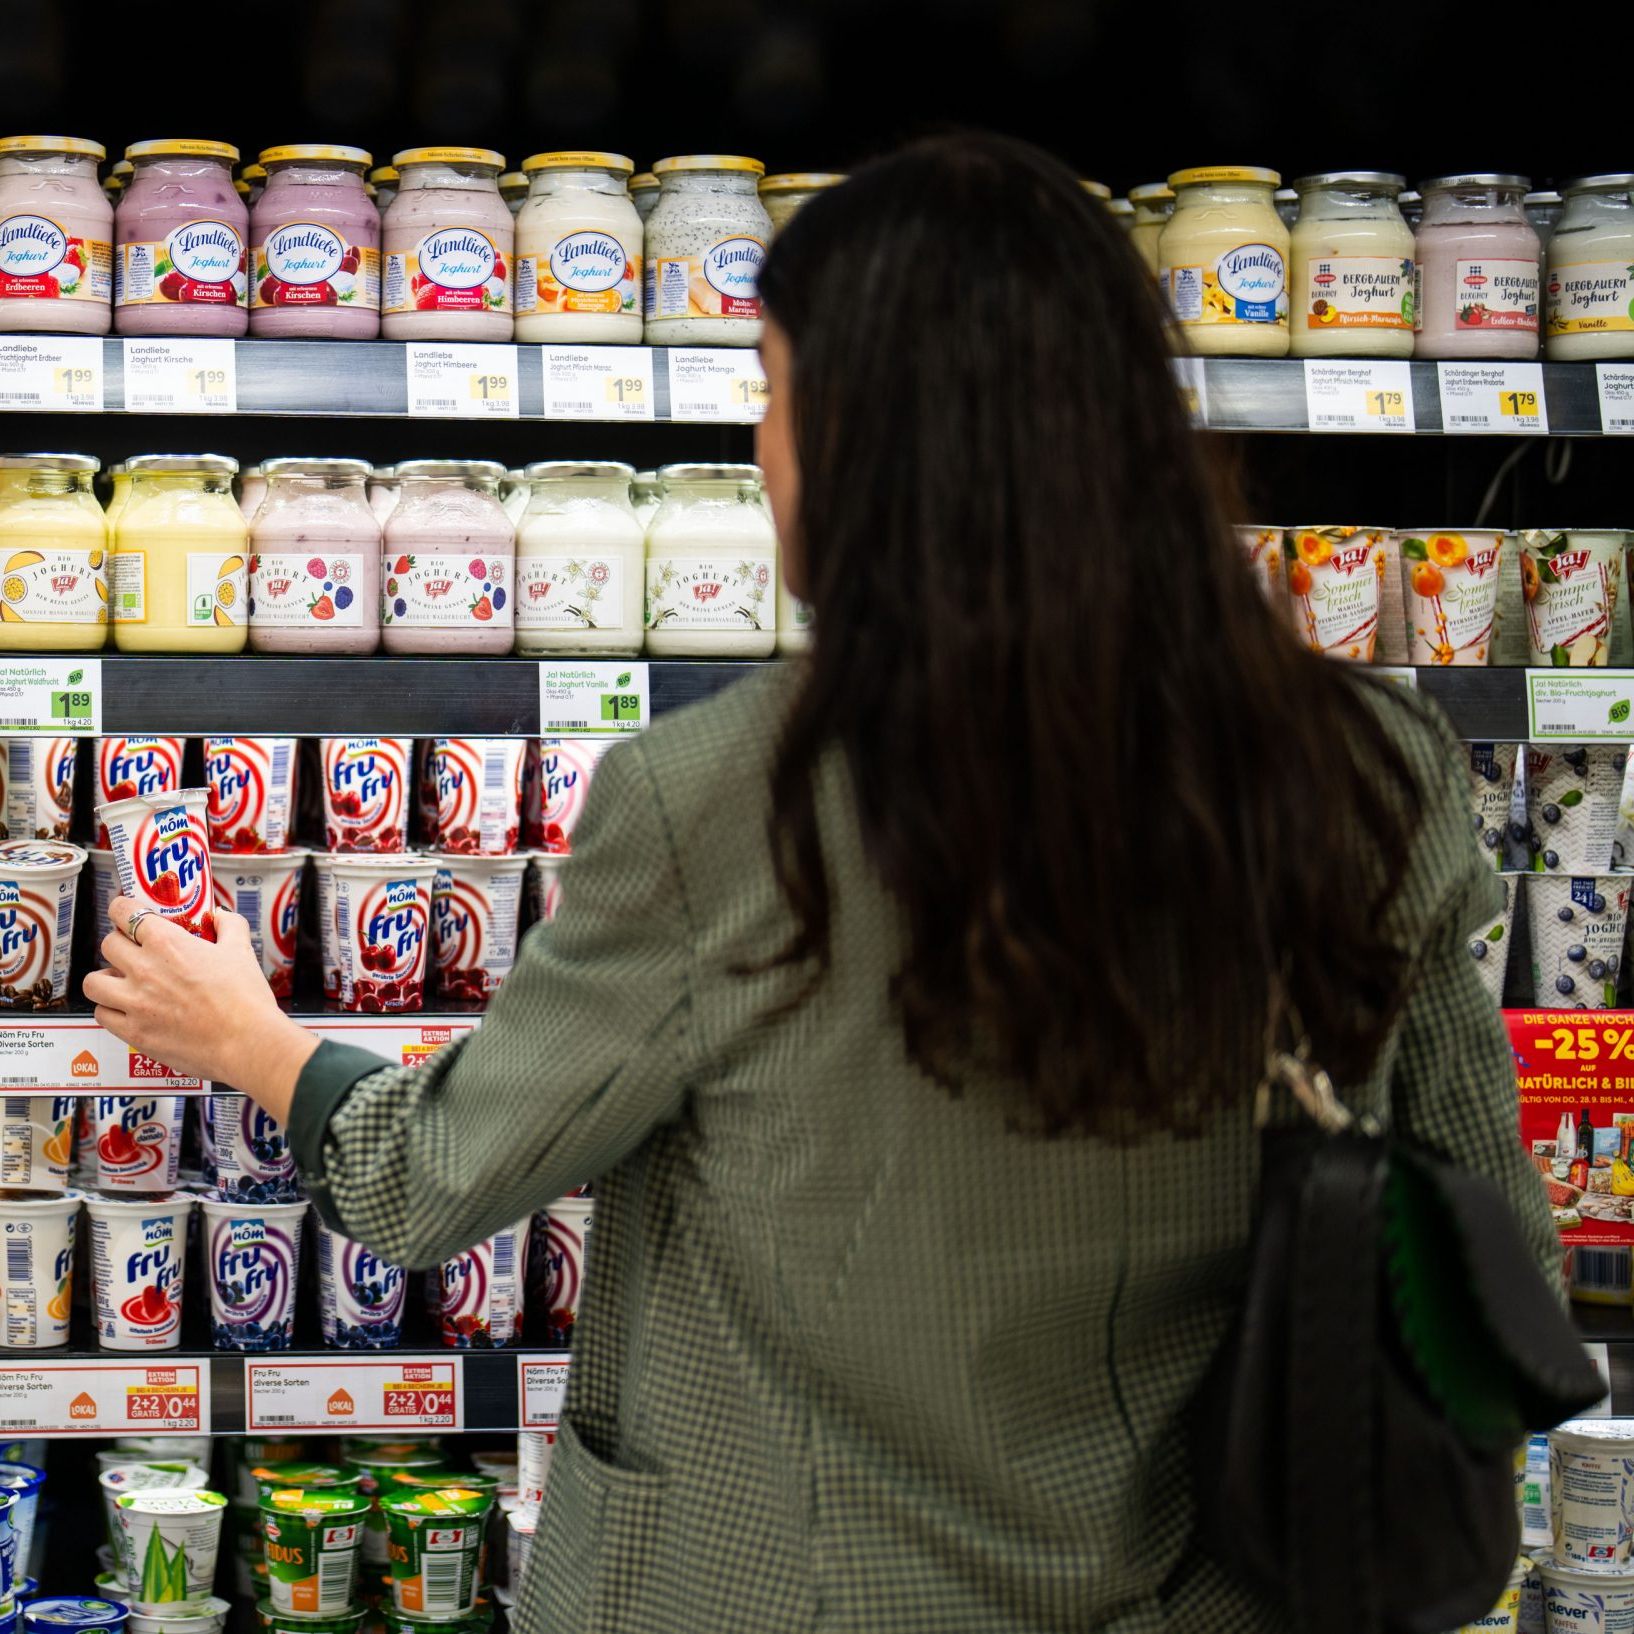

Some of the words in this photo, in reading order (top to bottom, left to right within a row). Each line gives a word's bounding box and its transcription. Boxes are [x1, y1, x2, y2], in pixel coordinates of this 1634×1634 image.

[0, 223, 61, 250] Landliebe
[179, 229, 238, 258] Landliebe
[274, 231, 338, 258] Landliebe
[427, 236, 491, 263] Landliebe
[5, 251, 49, 264] Joghurt
[558, 240, 623, 266] Landliebe
[188, 255, 230, 270] Joghurt
[283, 257, 327, 272] Joghurt
[438, 262, 482, 276] Joghurt
[1227, 252, 1283, 277] Landliebe
[569, 264, 613, 279] Joghurt
[1343, 273, 1400, 285] BERGBAUERN
[5, 283, 46, 292] Erdbeeren
[1238, 277, 1275, 291] Joghurt
[1565, 278, 1627, 293] BERGBAUERN
[193, 289, 226, 298] Kirschen
[285, 291, 321, 300] Kirschen
[437, 295, 481, 304] Himbeeren
[1350, 286, 1395, 302] Joghurt
[1501, 288, 1536, 305] Joghurt
[1570, 290, 1619, 308] Joghurt
[1244, 308, 1269, 318] Vanille
[1578, 320, 1608, 329] Vanille
[130, 346, 170, 354] Landliebe
[413, 351, 453, 359] Landliebe
[130, 356, 162, 365] Joghurt
[549, 354, 589, 362] Landliebe
[675, 355, 714, 364] Landliebe
[1480, 370, 1505, 379] Berghof
[32, 563, 93, 581] JOGHURT
[408, 568, 471, 586] JOGHURT
[676, 572, 739, 589] JOGHURT
[1536, 579, 1598, 606] Sommer
[559, 671, 596, 679] Natürlich
[559, 681, 585, 690] Joghurt
[109, 751, 155, 787] fru
[333, 756, 376, 791] fru
[138, 766, 170, 796] fru
[218, 769, 251, 801] fru
[361, 770, 394, 803] fru
[439, 771, 464, 800] fru
[547, 771, 577, 800] fru
[160, 817, 189, 836] nöm
[146, 837, 189, 882] fru
[178, 849, 206, 889] fru
[388, 890, 417, 904] nöm
[368, 909, 413, 946] fru
[440, 912, 468, 945] fru
[2, 922, 38, 955] fru
[396, 923, 424, 958] fru
[1523, 1014, 1546, 1025] DIE
[1547, 1014, 1591, 1025] GANZE
[17, 1031, 30, 1039] Fru
[31, 1031, 45, 1039] Fru
[73, 1062, 97, 1074] LOKAL
[133, 1068, 163, 1077] GRATIS
[1580, 1064, 1597, 1072] AUF
[170, 1079, 180, 1088] kg
[1515, 1073, 1598, 1090] NATÜRLICH
[1601, 1077, 1612, 1090] &
[1543, 1096, 1561, 1104] VON
[121, 1100, 157, 1134] fru
[145, 1225, 173, 1240] nöm
[233, 1227, 265, 1241] nöm
[126, 1245, 170, 1284] fru
[218, 1247, 261, 1281] fru
[156, 1257, 182, 1295] fru
[245, 1260, 280, 1296] fru
[444, 1258, 472, 1289] fru
[30, 1373, 44, 1381] Fru
[253, 1369, 267, 1377] Fru
[267, 1369, 281, 1377] Fru
[526, 1376, 556, 1385] Diverse
[253, 1378, 282, 1386] diverse
[283, 1378, 310, 1387] Sorten
[328, 1400, 353, 1412] LOKAL
[388, 1392, 416, 1406] 2+2
[71, 1405, 96, 1416] LOKAL
[131, 1410, 160, 1418] GRATIS
[388, 1406, 417, 1414] GRATIS
[423, 1416, 433, 1425] kg
